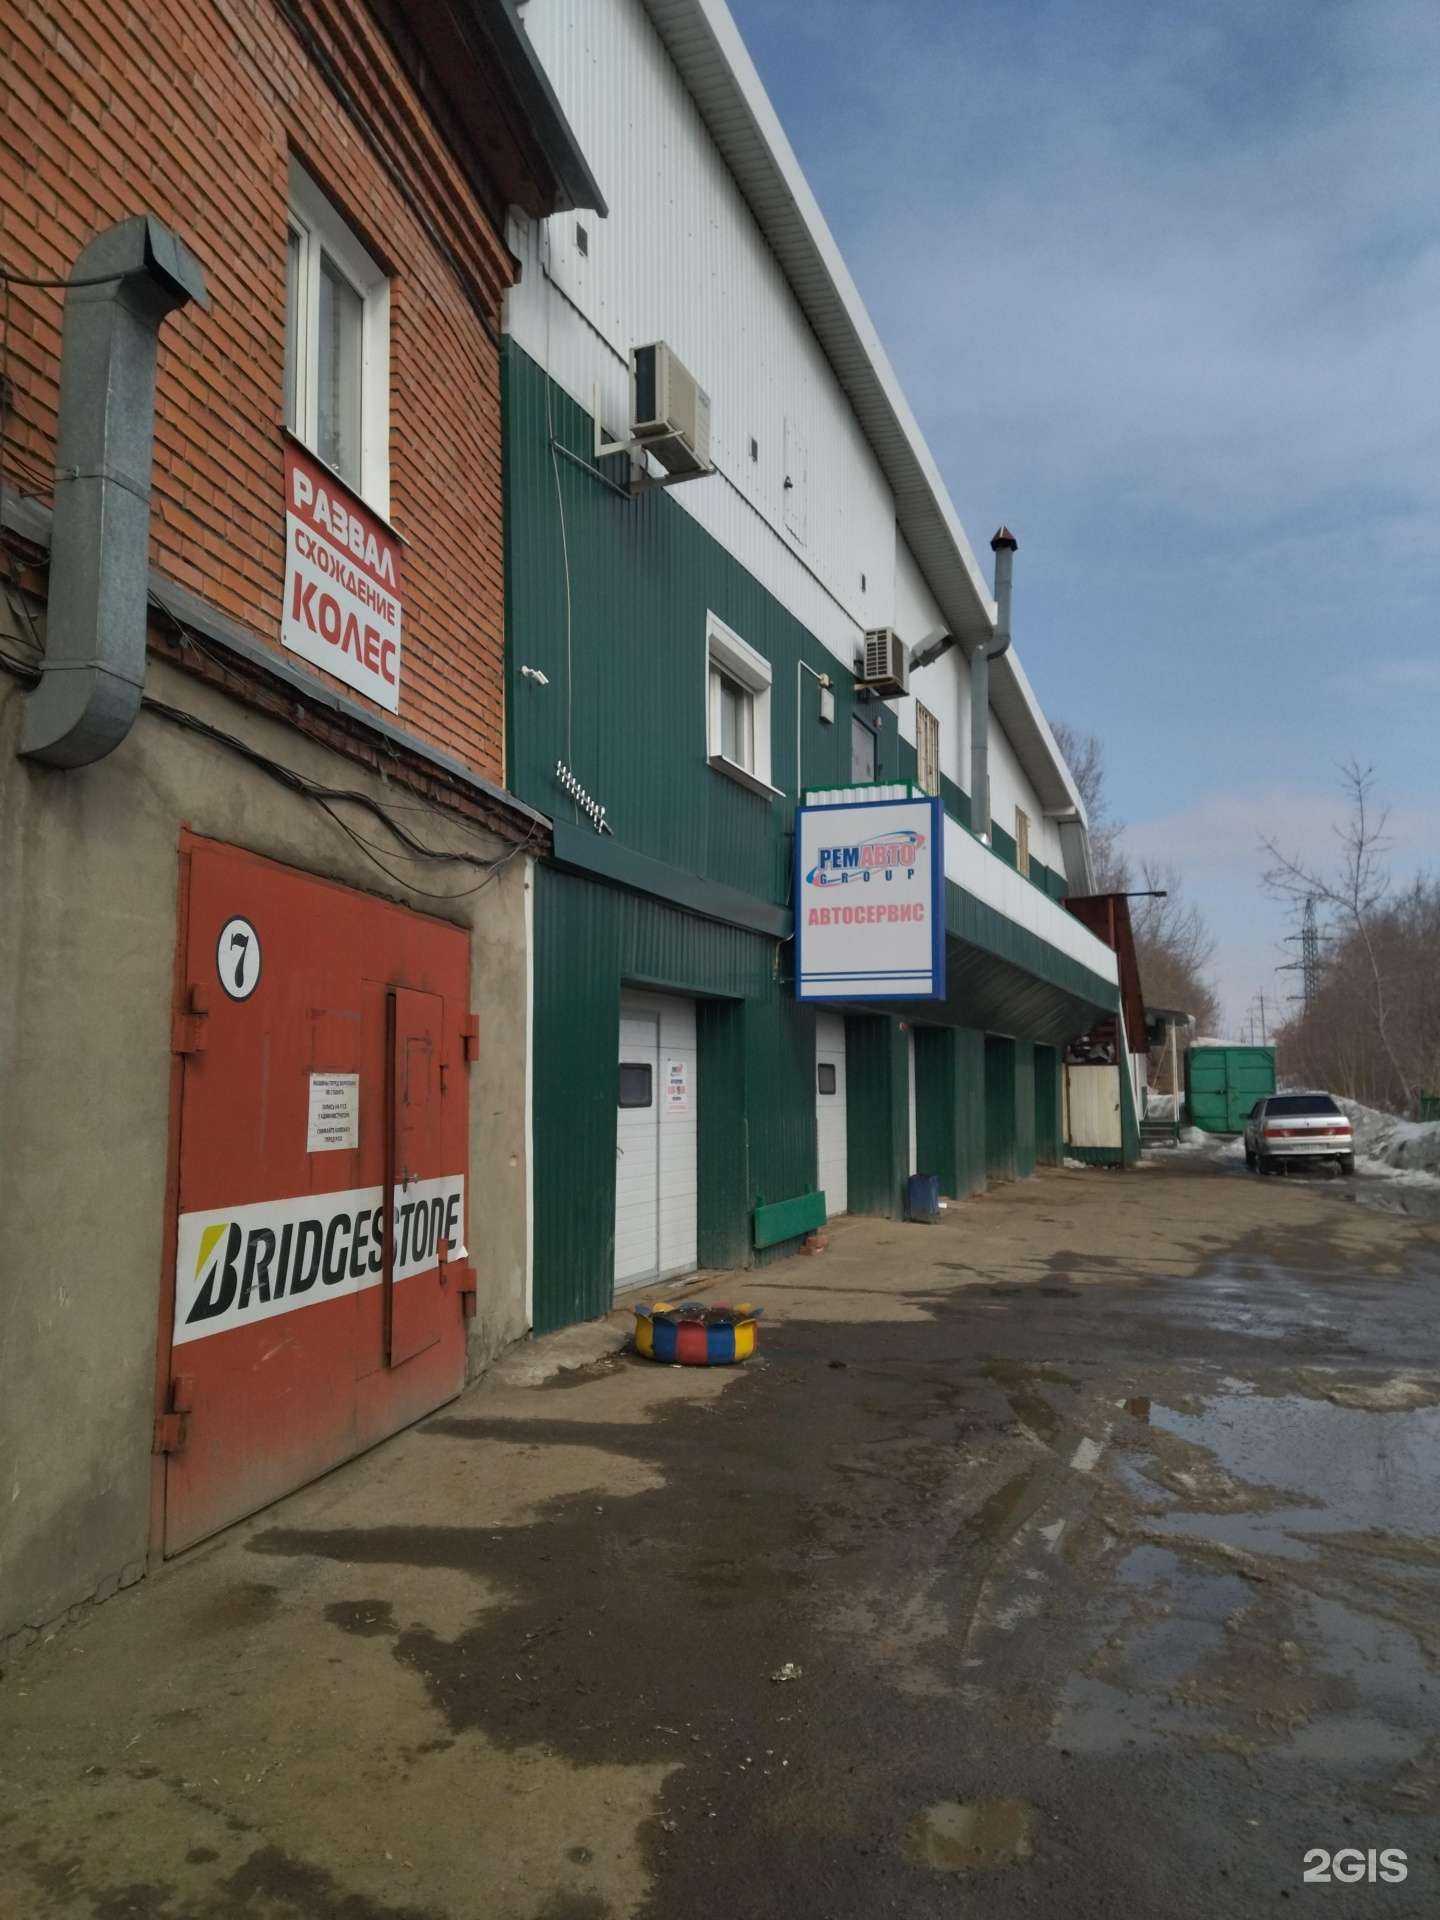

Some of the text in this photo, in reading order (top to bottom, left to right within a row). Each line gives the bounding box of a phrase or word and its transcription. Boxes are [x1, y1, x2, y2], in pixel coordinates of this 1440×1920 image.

[293, 467, 396, 588] РАЗВАЛ
[294, 528, 395, 626] СХОЖДЕНИЕ
[292, 571, 396, 685] КОЛЕС
[230, 933, 249, 988] 7
[808, 903, 925, 926] АВТОСЕРВИС
[185, 1193, 460, 1324] BRIDGESTONE
